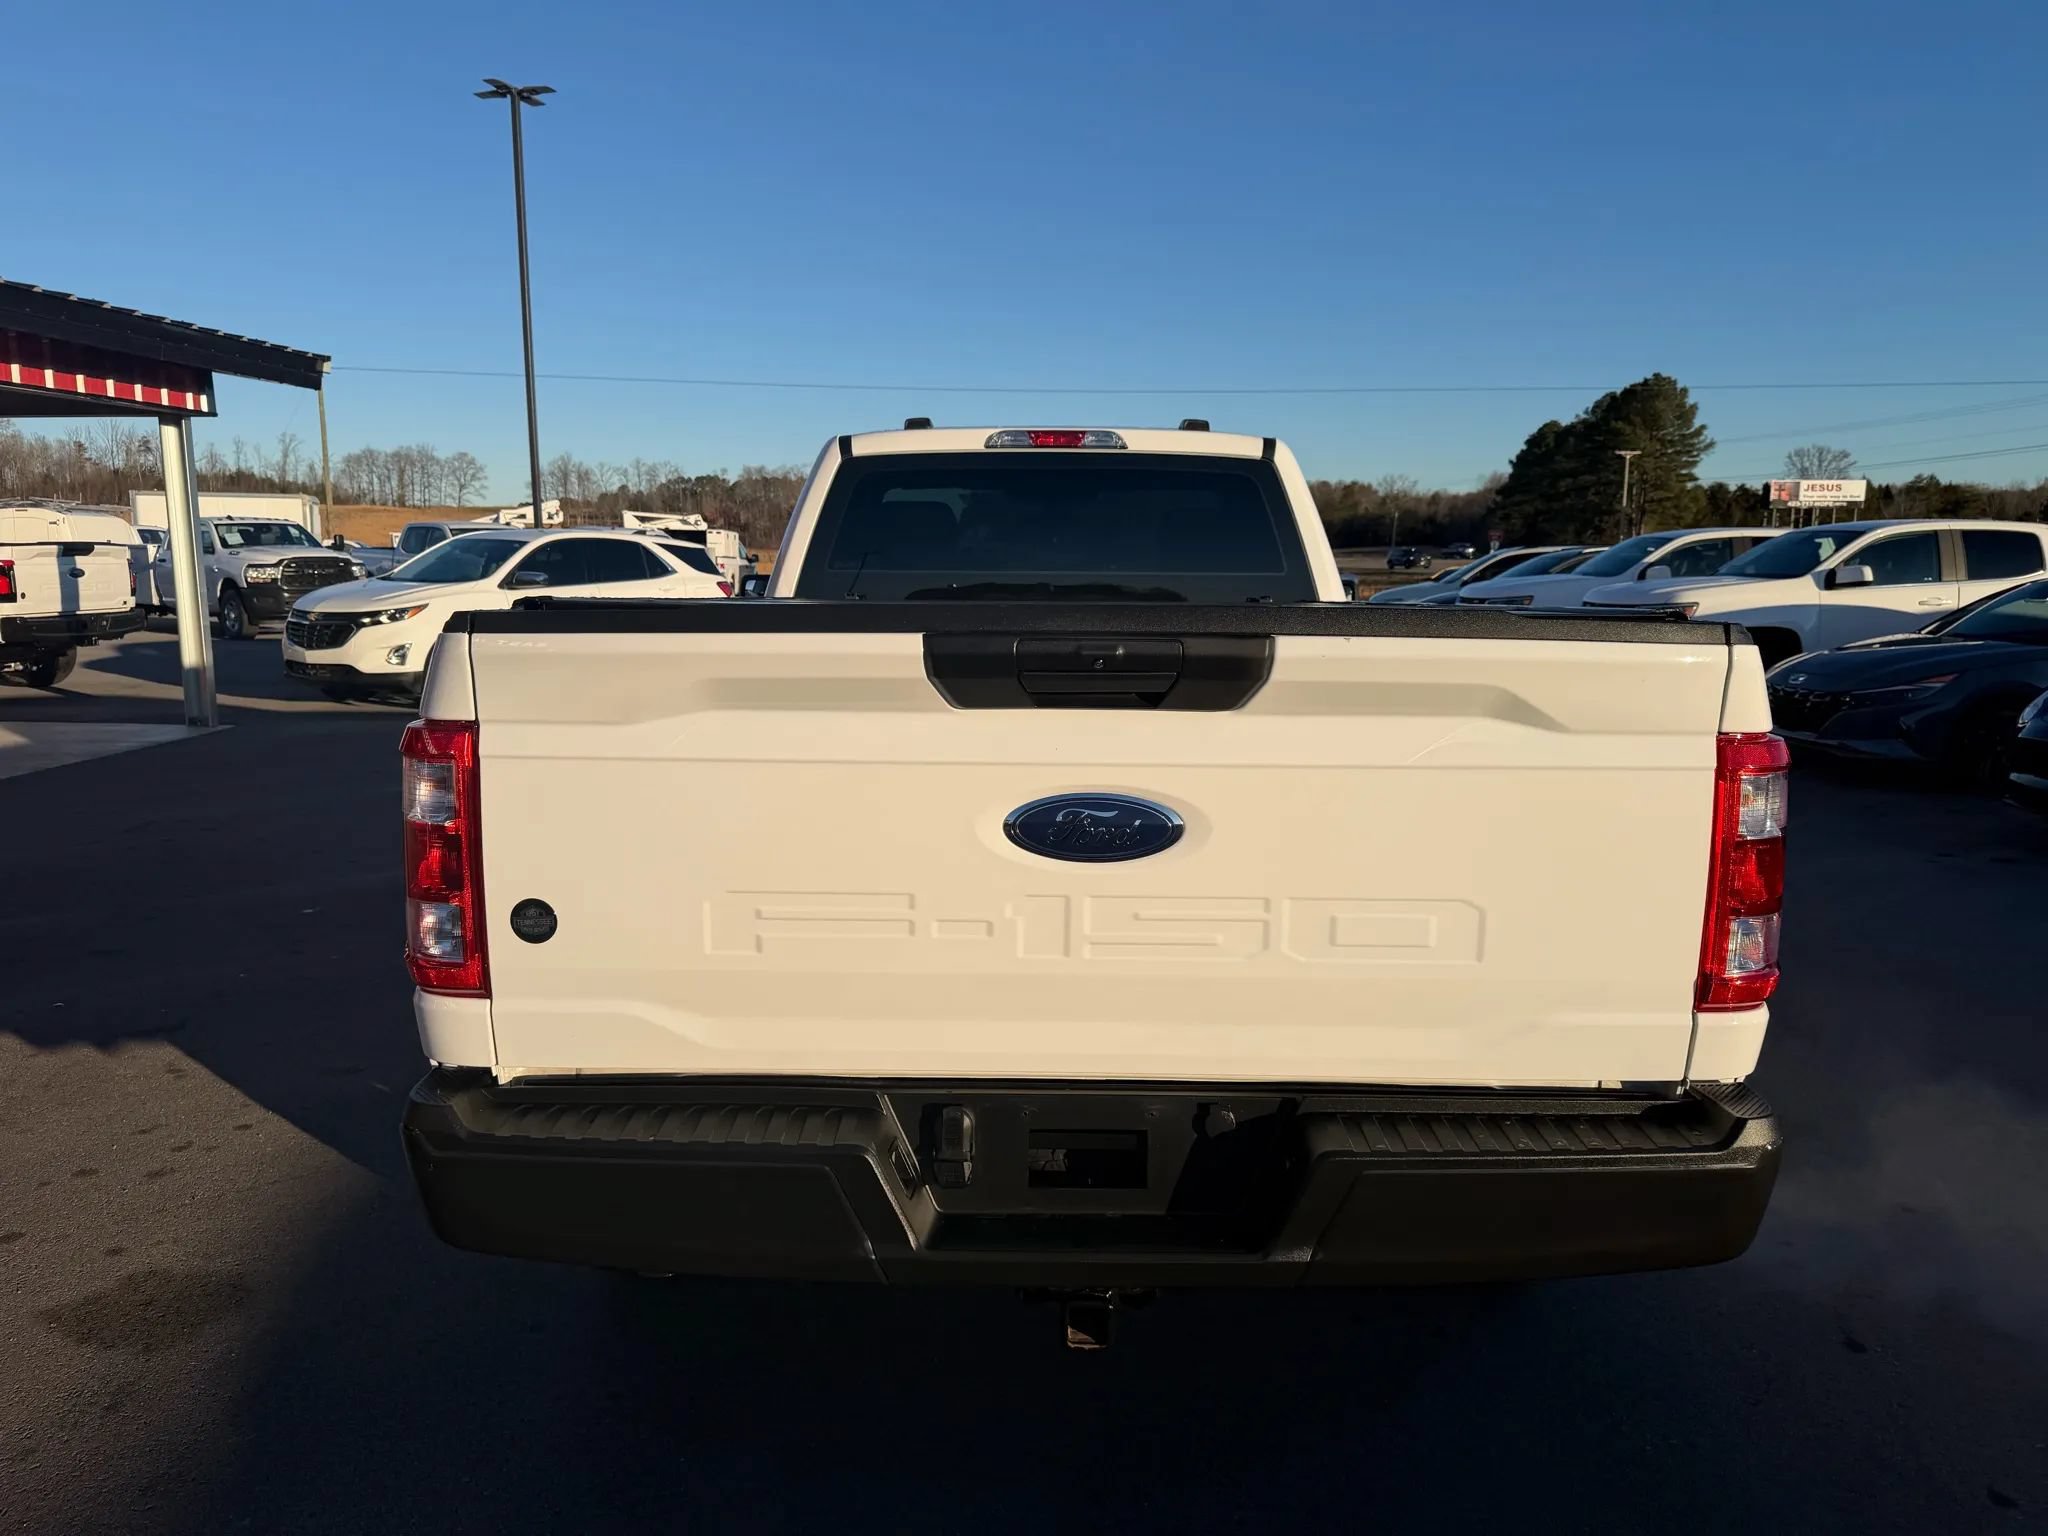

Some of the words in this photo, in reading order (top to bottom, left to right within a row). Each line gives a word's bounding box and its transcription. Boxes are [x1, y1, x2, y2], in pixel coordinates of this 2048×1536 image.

[1803, 483, 1843, 492] JESUS
[1047, 807, 1142, 848] Ford
[702, 890, 1487, 965] F-150
